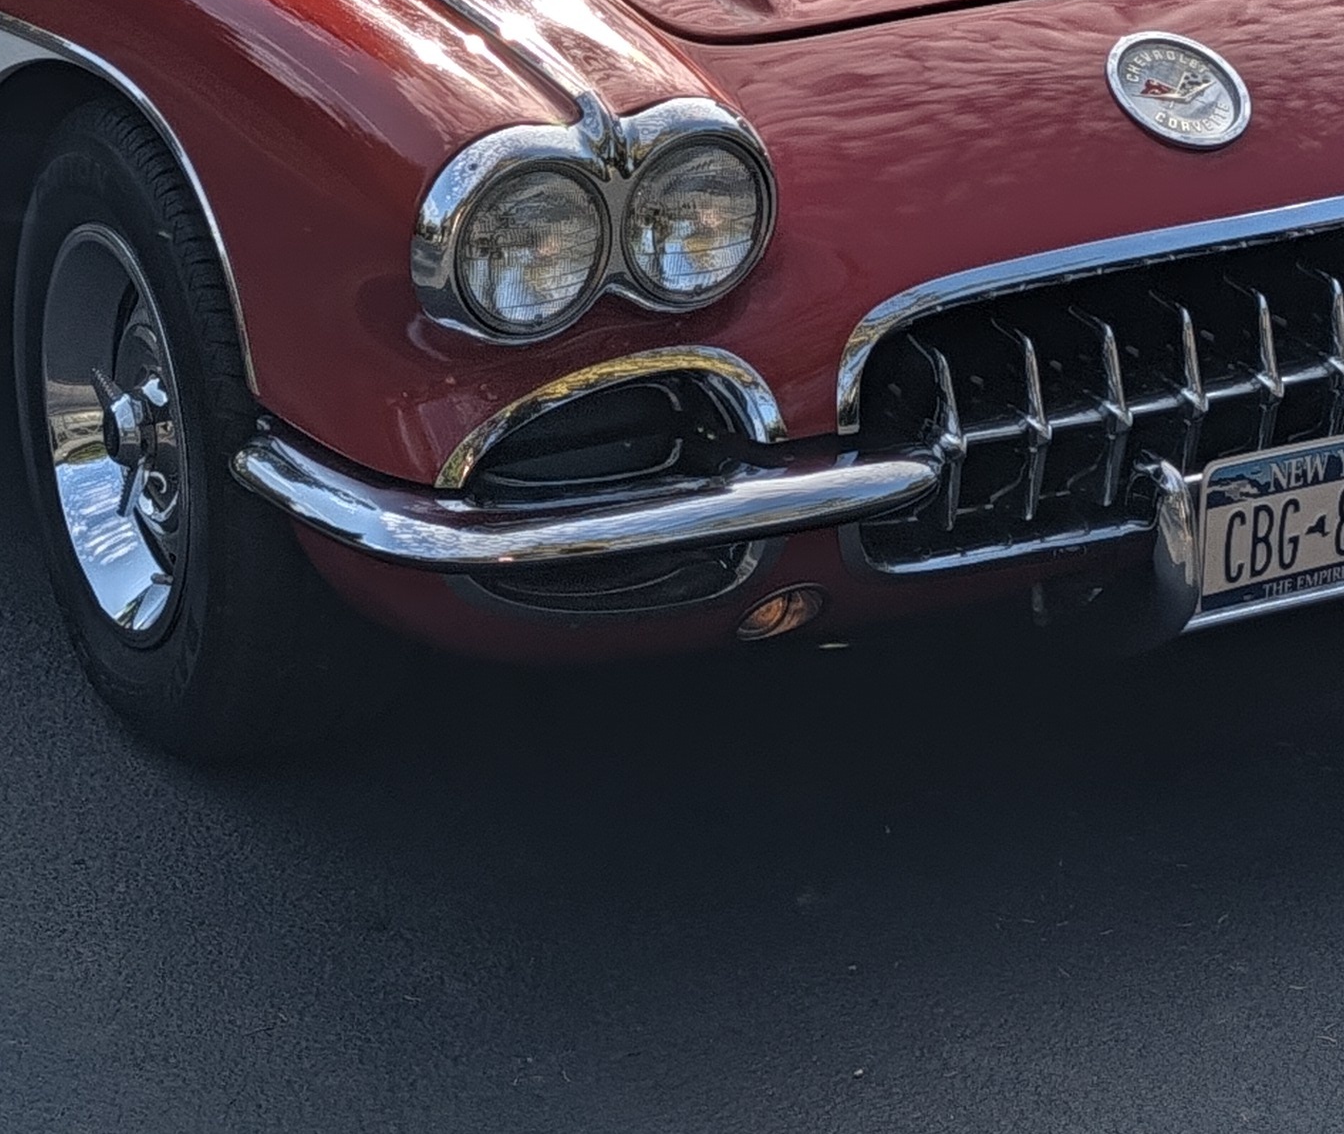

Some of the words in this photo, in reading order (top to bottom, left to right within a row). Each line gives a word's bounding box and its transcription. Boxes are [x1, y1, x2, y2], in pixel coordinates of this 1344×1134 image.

[1126, 49, 1209, 82] CHEVROLET
[1155, 102, 1229, 132] CORVETTE
[1269, 453, 1330, 492] NEW
[1224, 498, 1301, 583] CBG
[1262, 578, 1293, 599] THE
